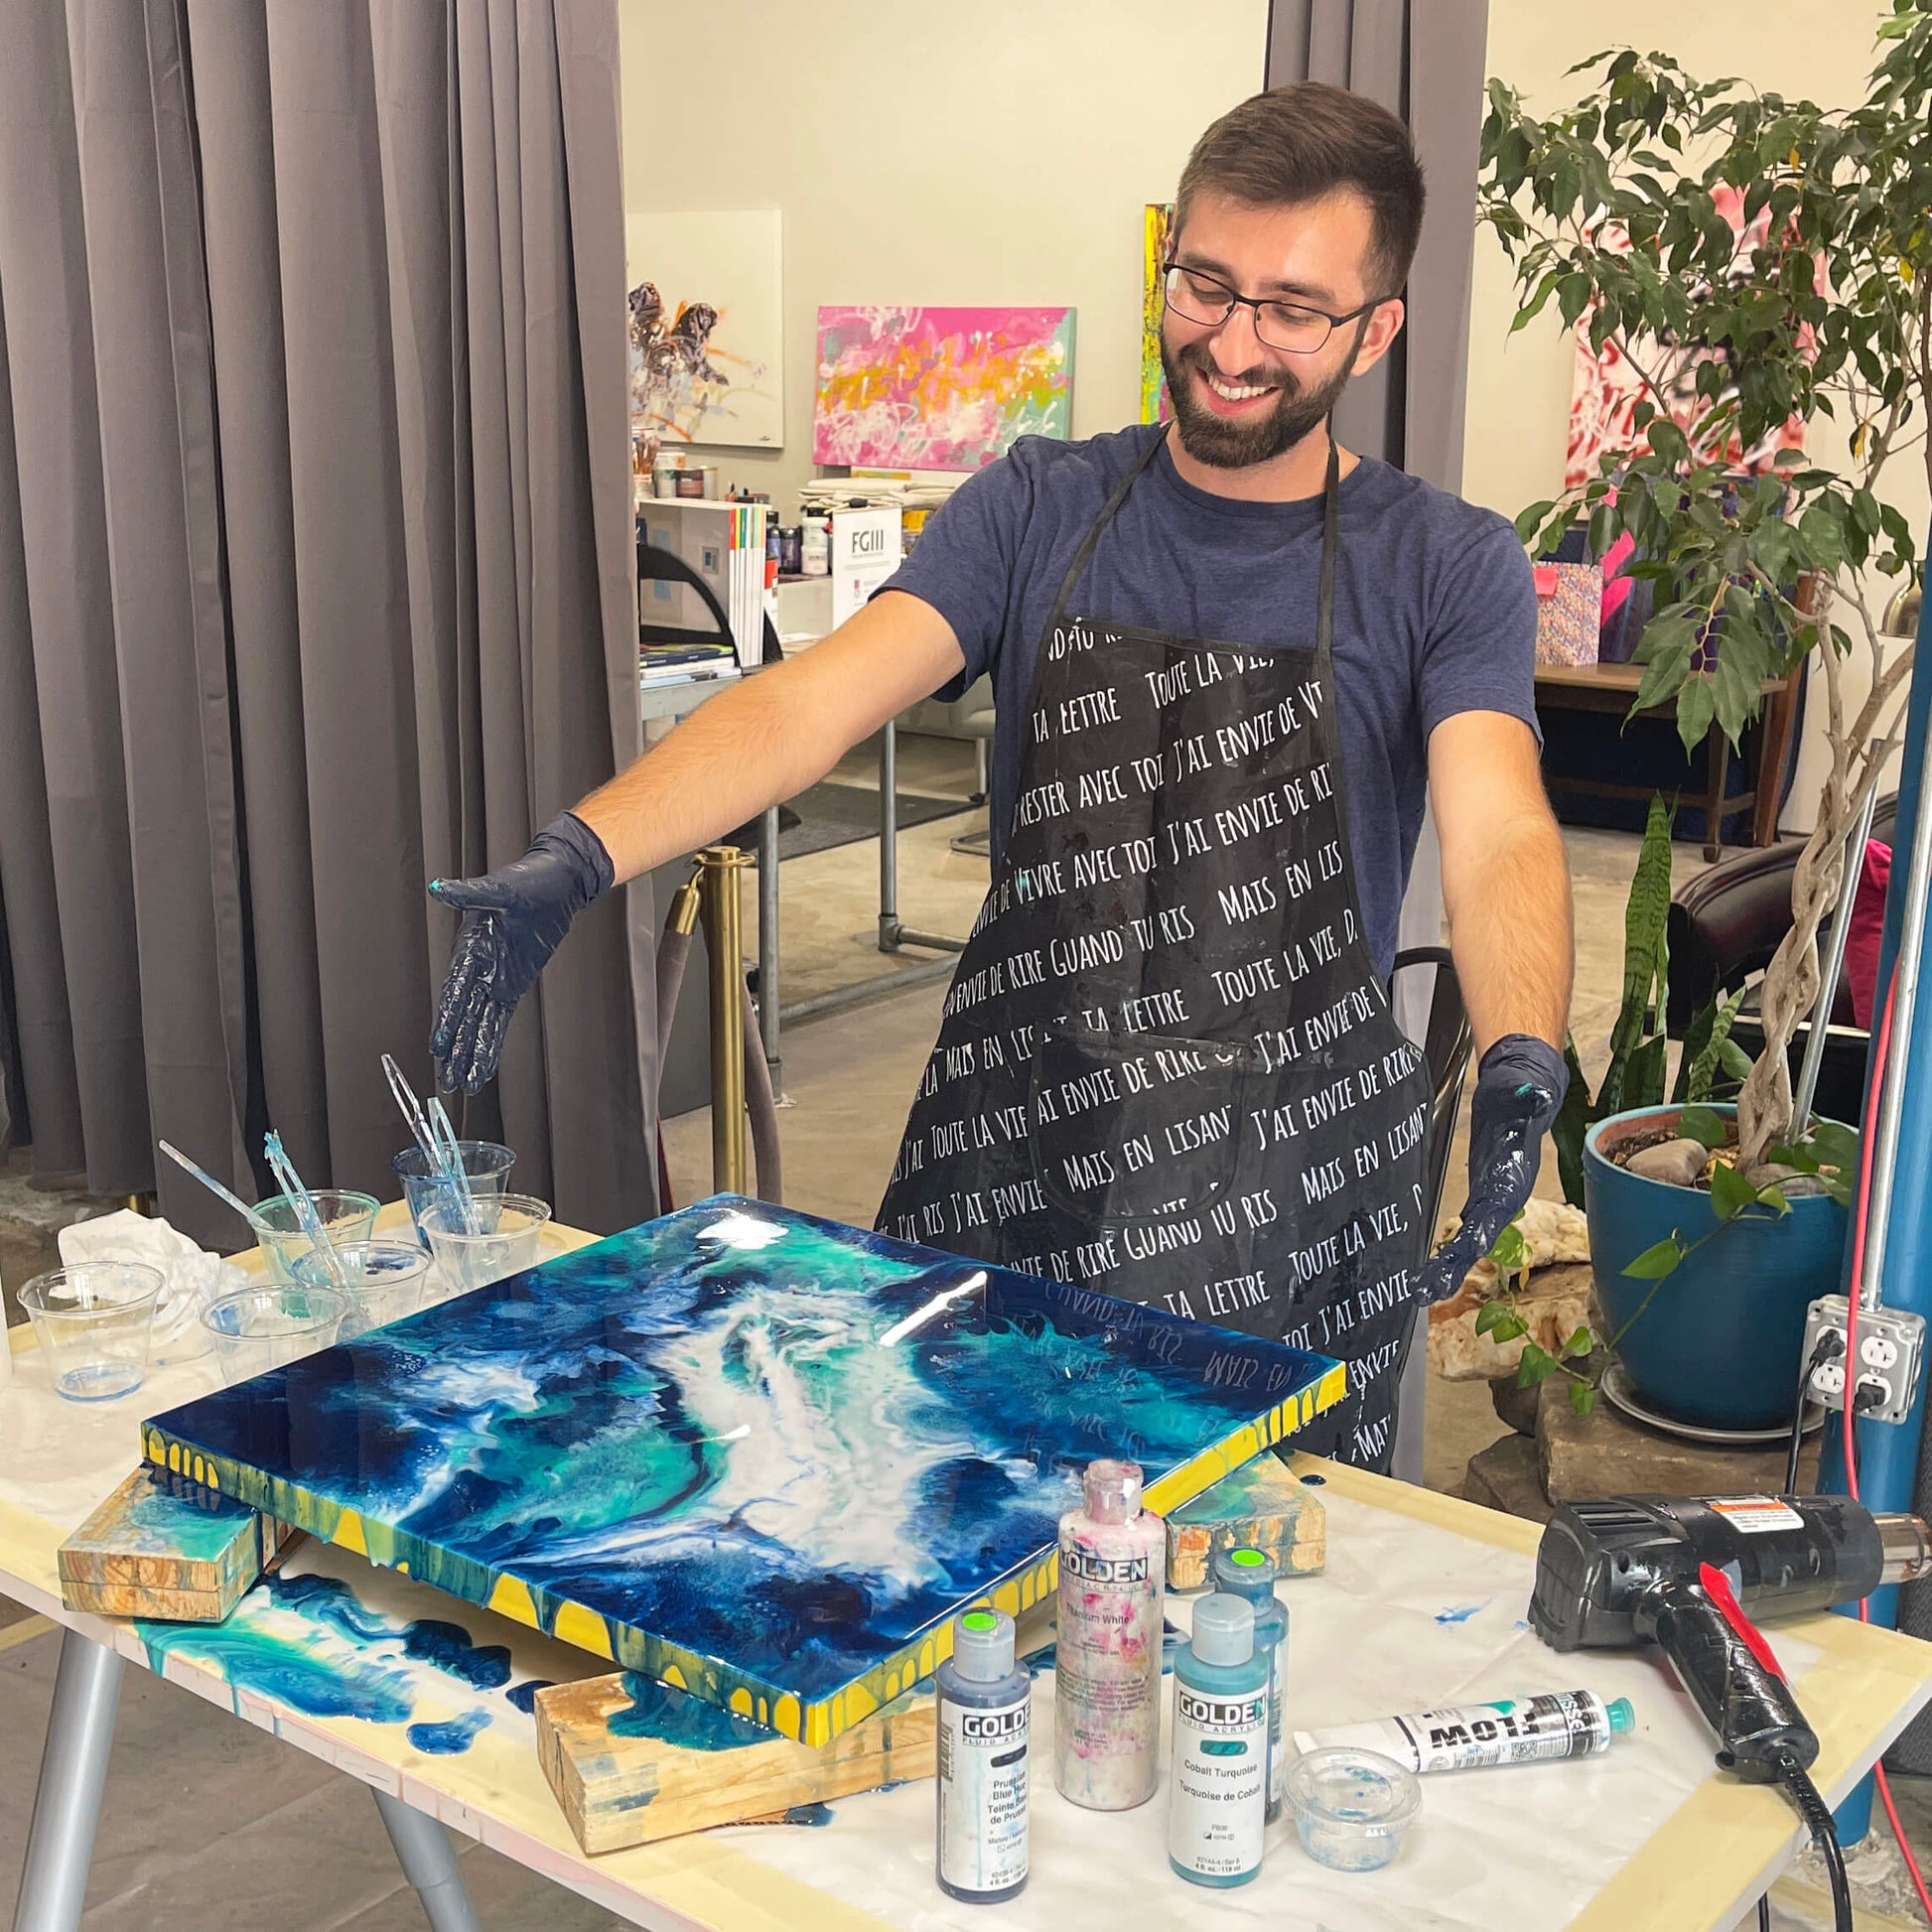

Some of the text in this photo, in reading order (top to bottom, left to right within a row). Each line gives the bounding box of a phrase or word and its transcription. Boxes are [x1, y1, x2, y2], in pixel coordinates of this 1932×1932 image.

[852, 528, 885, 554] FGIII
[1033, 708, 1050, 744] TA
[1059, 687, 1122, 735] LETTRE
[1144, 660, 1191, 709] TOUTE
[1194, 651, 1223, 688] LA
[1079, 765, 1128, 809] AVEC
[1130, 754, 1164, 793] TOI
[1173, 735, 1212, 783] J'AI
[1215, 710, 1276, 762] ENVIE
[1278, 697, 1302, 735] DE
[1000, 880, 1011, 913] DE
[1014, 862, 1066, 905] VIVRE
[1074, 846, 1122, 889] AVEC
[1121, 836, 1158, 875] TOI
[1167, 818, 1212, 865] J'AI
[1215, 792, 1284, 846] ENVIE
[1283, 778, 1311, 816] DE
[1310, 761, 1333, 802] RI
[955, 969, 987, 1015] ENVIE
[990, 962, 1005, 997] DE
[1007, 949, 1046, 990] RIRE
[1130, 915, 1155, 952] TU
[1159, 905, 1195, 944] RIS
[1217, 877, 1277, 925] MAIS
[1285, 859, 1312, 898] EN
[946, 1042, 975, 1082] MAIS
[983, 1035, 1004, 1070] EN
[1123, 989, 1189, 1034] LETTRE
[1210, 958, 1281, 1006] TOUTE
[1283, 943, 1310, 982] LA
[1309, 925, 1341, 966] VIE,
[904, 1140, 923, 1180] J'AI
[930, 1121, 969, 1160] TOUTE
[971, 1114, 995, 1149] LA
[995, 1106, 1029, 1141] VIE
[1060, 1068, 1121, 1116] ENVIE
[1122, 1057, 1155, 1094] DE
[1254, 1027, 1302, 1074] J'AI
[1304, 999, 1352, 1051] ENVIE
[1352, 986, 1376, 1023] DE
[922, 1201, 945, 1237] RIS
[949, 1191, 989, 1233] J'AI
[991, 1178, 1047, 1221] ENVIE
[1062, 1150, 1115, 1192] MAIS
[1123, 1134, 1155, 1173] EN
[1250, 1104, 1300, 1152] J'AI
[1302, 1077, 1356, 1130] ENVIE
[1358, 1063, 1381, 1101] DE
[1050, 1250, 1073, 1284] DE
[1076, 1239, 1121, 1279] RIRE
[1241, 1188, 1278, 1229] RIS
[1301, 1157, 1345, 1205] MAIS
[1354, 1141, 1379, 1178] EN
[1204, 1270, 1271, 1317] LETTRE
[1288, 1236, 1340, 1285] TOUTE
[1343, 1221, 1366, 1257] LA
[1368, 1203, 1408, 1242] VIE,
[1282, 1269, 1412, 1352] TOI J'AI ENVIE
[1179, 1692, 1266, 1725] GOLDEN
[1430, 1713, 1541, 1749] FLOW
[993, 1789, 1013, 1801] Blue
[1179, 1779, 1221, 1801] Turquoise
[1223, 1792, 1235, 1801] de
[1184, 1759, 1258, 1779] Cobalt Turquoise
